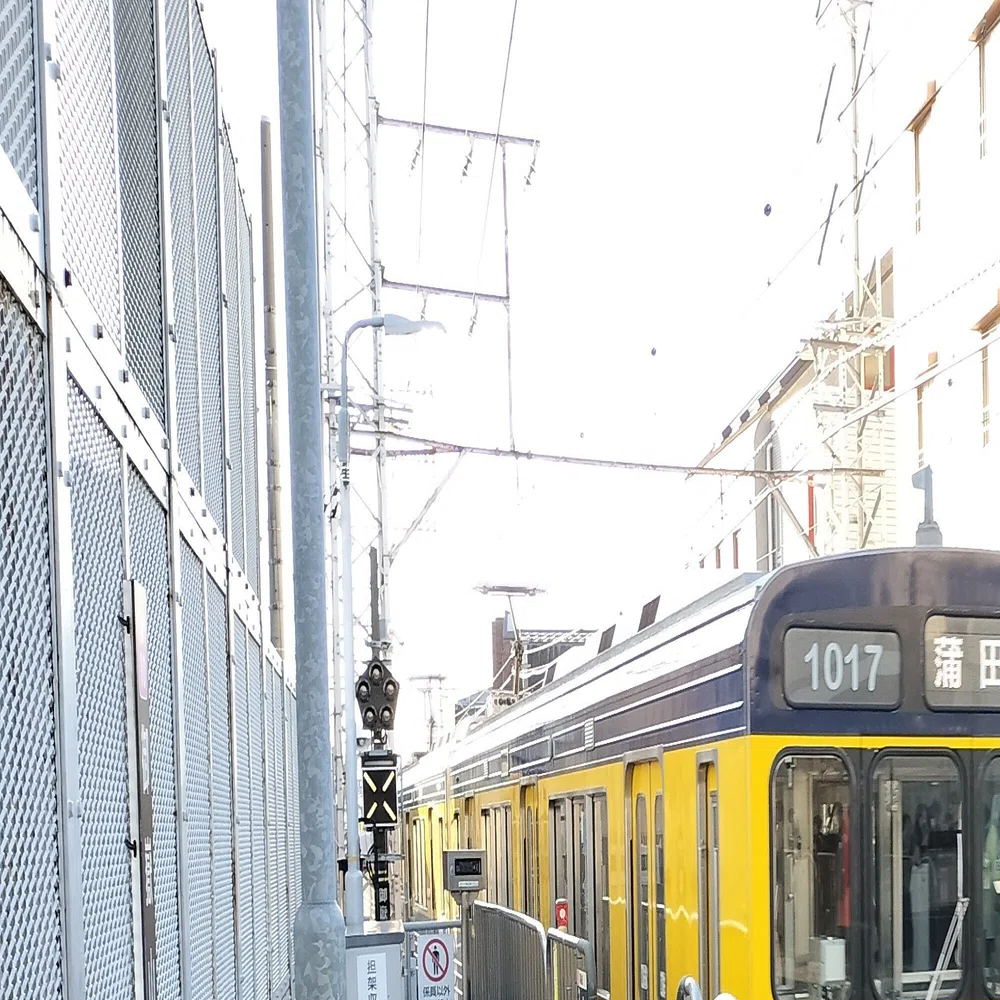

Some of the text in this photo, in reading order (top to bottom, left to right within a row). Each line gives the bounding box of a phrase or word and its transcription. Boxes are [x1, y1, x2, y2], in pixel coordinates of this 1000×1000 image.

[804, 642, 884, 692] 1017
[423, 985, 450, 997] 係員以外
